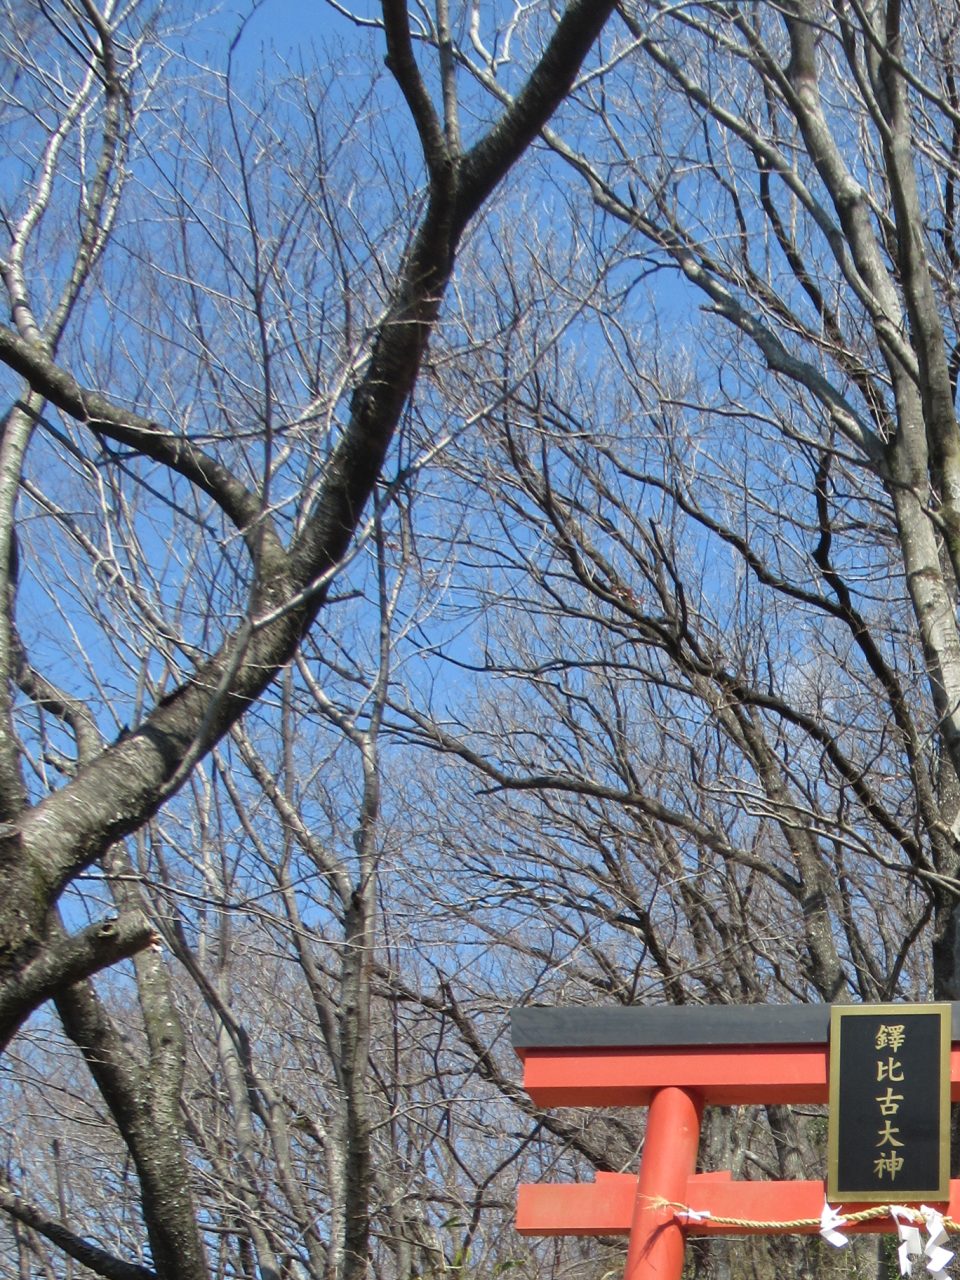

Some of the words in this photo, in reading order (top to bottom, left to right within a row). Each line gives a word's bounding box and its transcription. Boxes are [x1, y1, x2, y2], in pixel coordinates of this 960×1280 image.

[873, 1024, 906, 1182] 鐸比古大神
